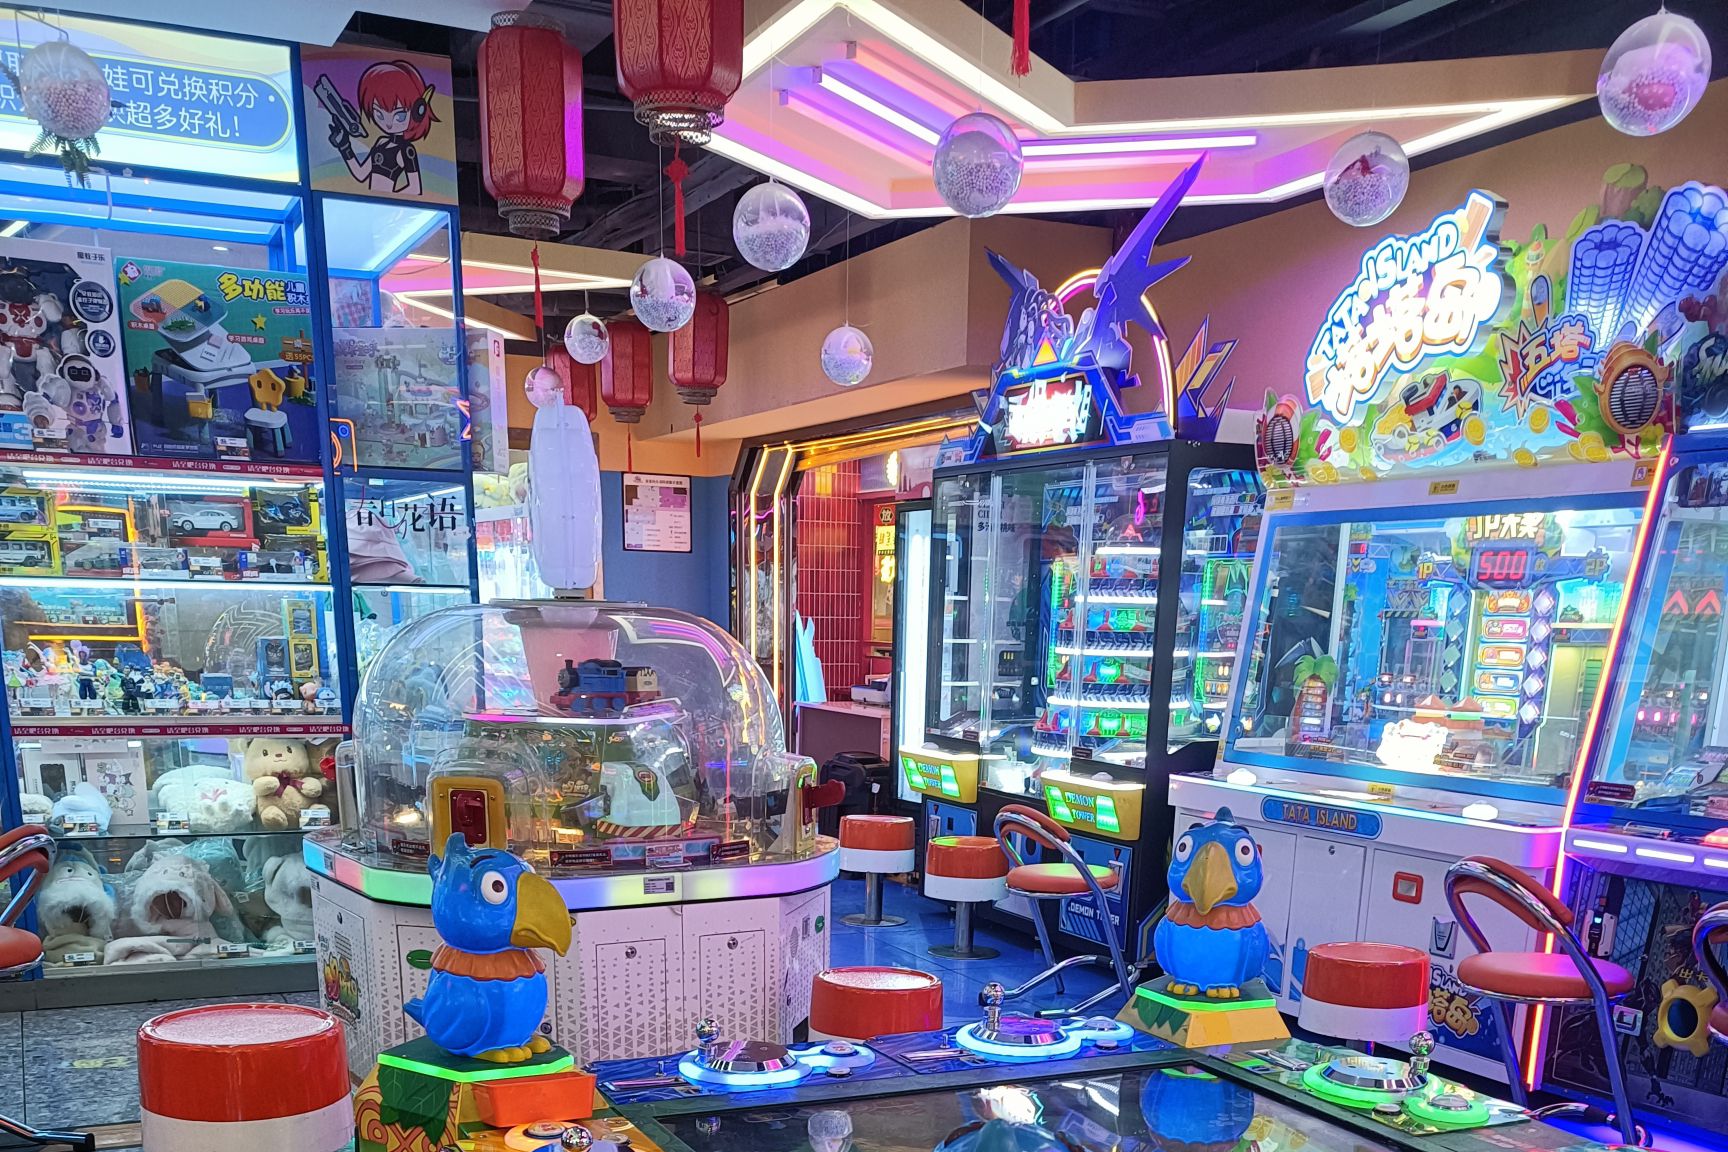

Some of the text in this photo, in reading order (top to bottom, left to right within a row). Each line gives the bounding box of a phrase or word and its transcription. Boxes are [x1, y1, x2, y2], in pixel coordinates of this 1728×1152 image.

[217, 272, 286, 301] 多功能
[286, 281, 308, 293] 儿童
[1314, 222, 1459, 360] TATA ISLAND
[286, 293, 309, 304] 积木
[1473, 511, 1545, 539] JP大奖
[1418, 562, 1433, 579] 1P
[1477, 550, 1527, 580] 500
[1585, 558, 1607, 576] 2P
[1064, 791, 1096, 807] DEMON
[1071, 808, 1096, 823] TOWER
[1282, 803, 1358, 831] TATA ISLAND
[1428, 987, 1480, 1036] 塔岛
